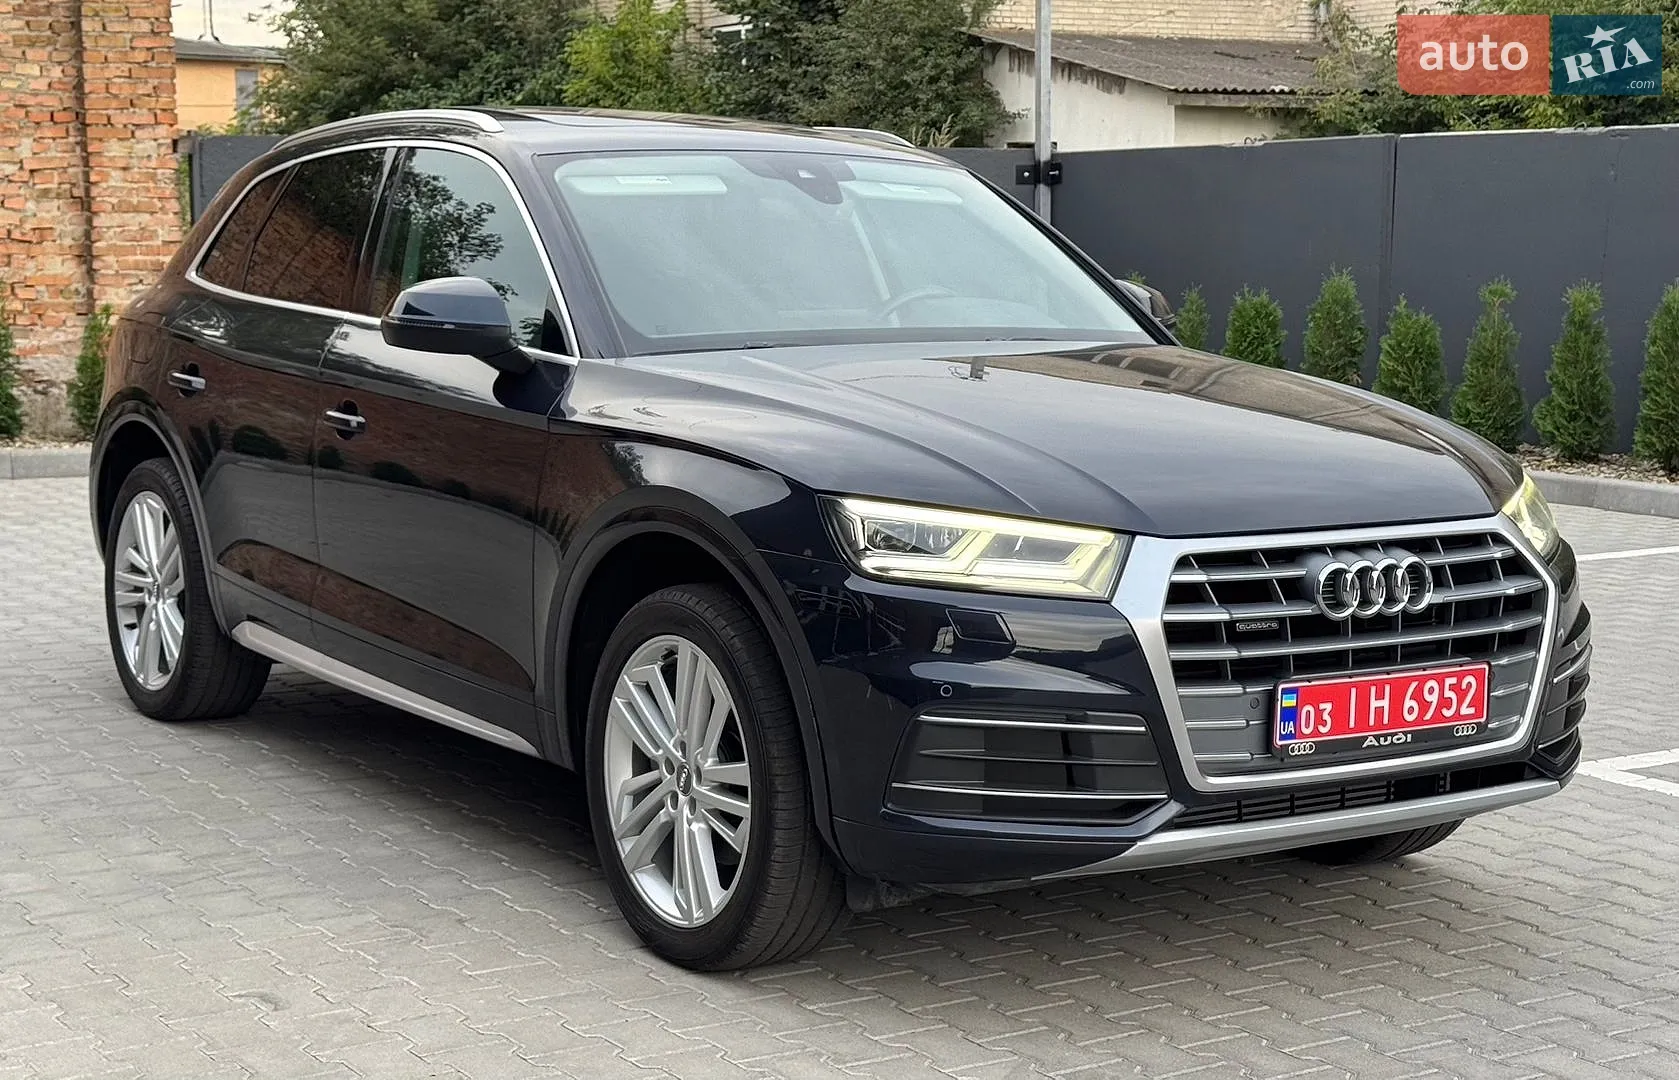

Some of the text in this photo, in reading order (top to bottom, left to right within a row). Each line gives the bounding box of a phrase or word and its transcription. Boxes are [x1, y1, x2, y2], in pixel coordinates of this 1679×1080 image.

[1238, 621, 1278, 631] quattro
[1300, 675, 1478, 735] 03 IH 6952
[1280, 721, 1295, 735] UA
[1362, 732, 1412, 748] Audi
